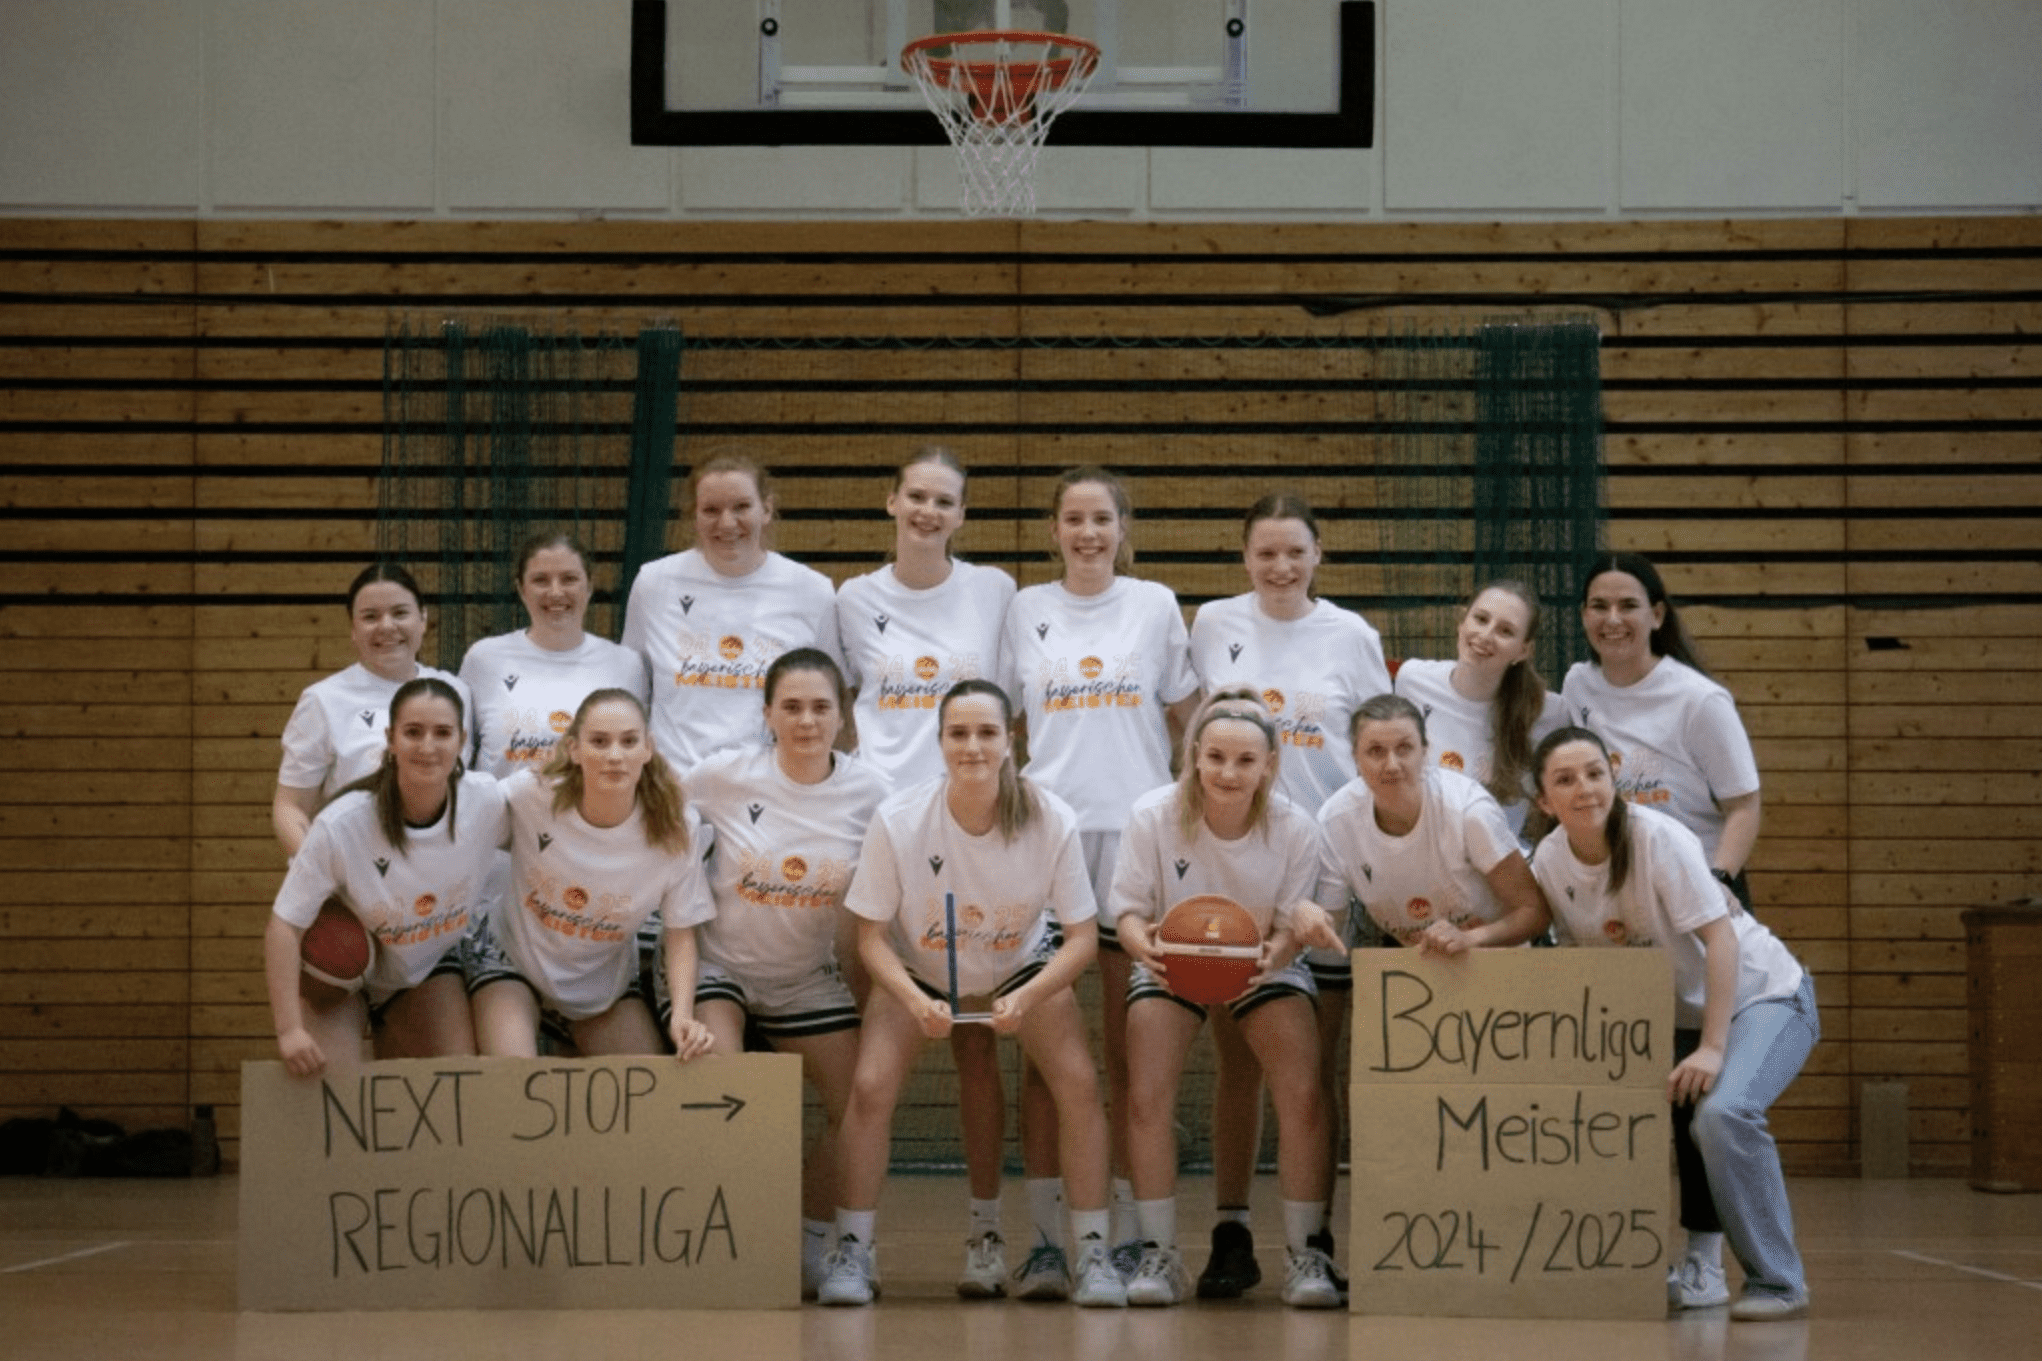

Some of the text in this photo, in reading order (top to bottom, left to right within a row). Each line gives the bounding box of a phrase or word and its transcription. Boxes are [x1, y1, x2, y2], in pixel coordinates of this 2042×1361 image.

[675, 672, 766, 689] MEISTE
[877, 695, 944, 711] MEIS
[1043, 692, 1143, 713] MEISTER
[1369, 969, 1653, 1082] Bayernliga
[321, 1066, 658, 1158] NEXT STOP
[1436, 1090, 1657, 1172] Meister
[328, 1184, 738, 1279] REGIONALLIGA
